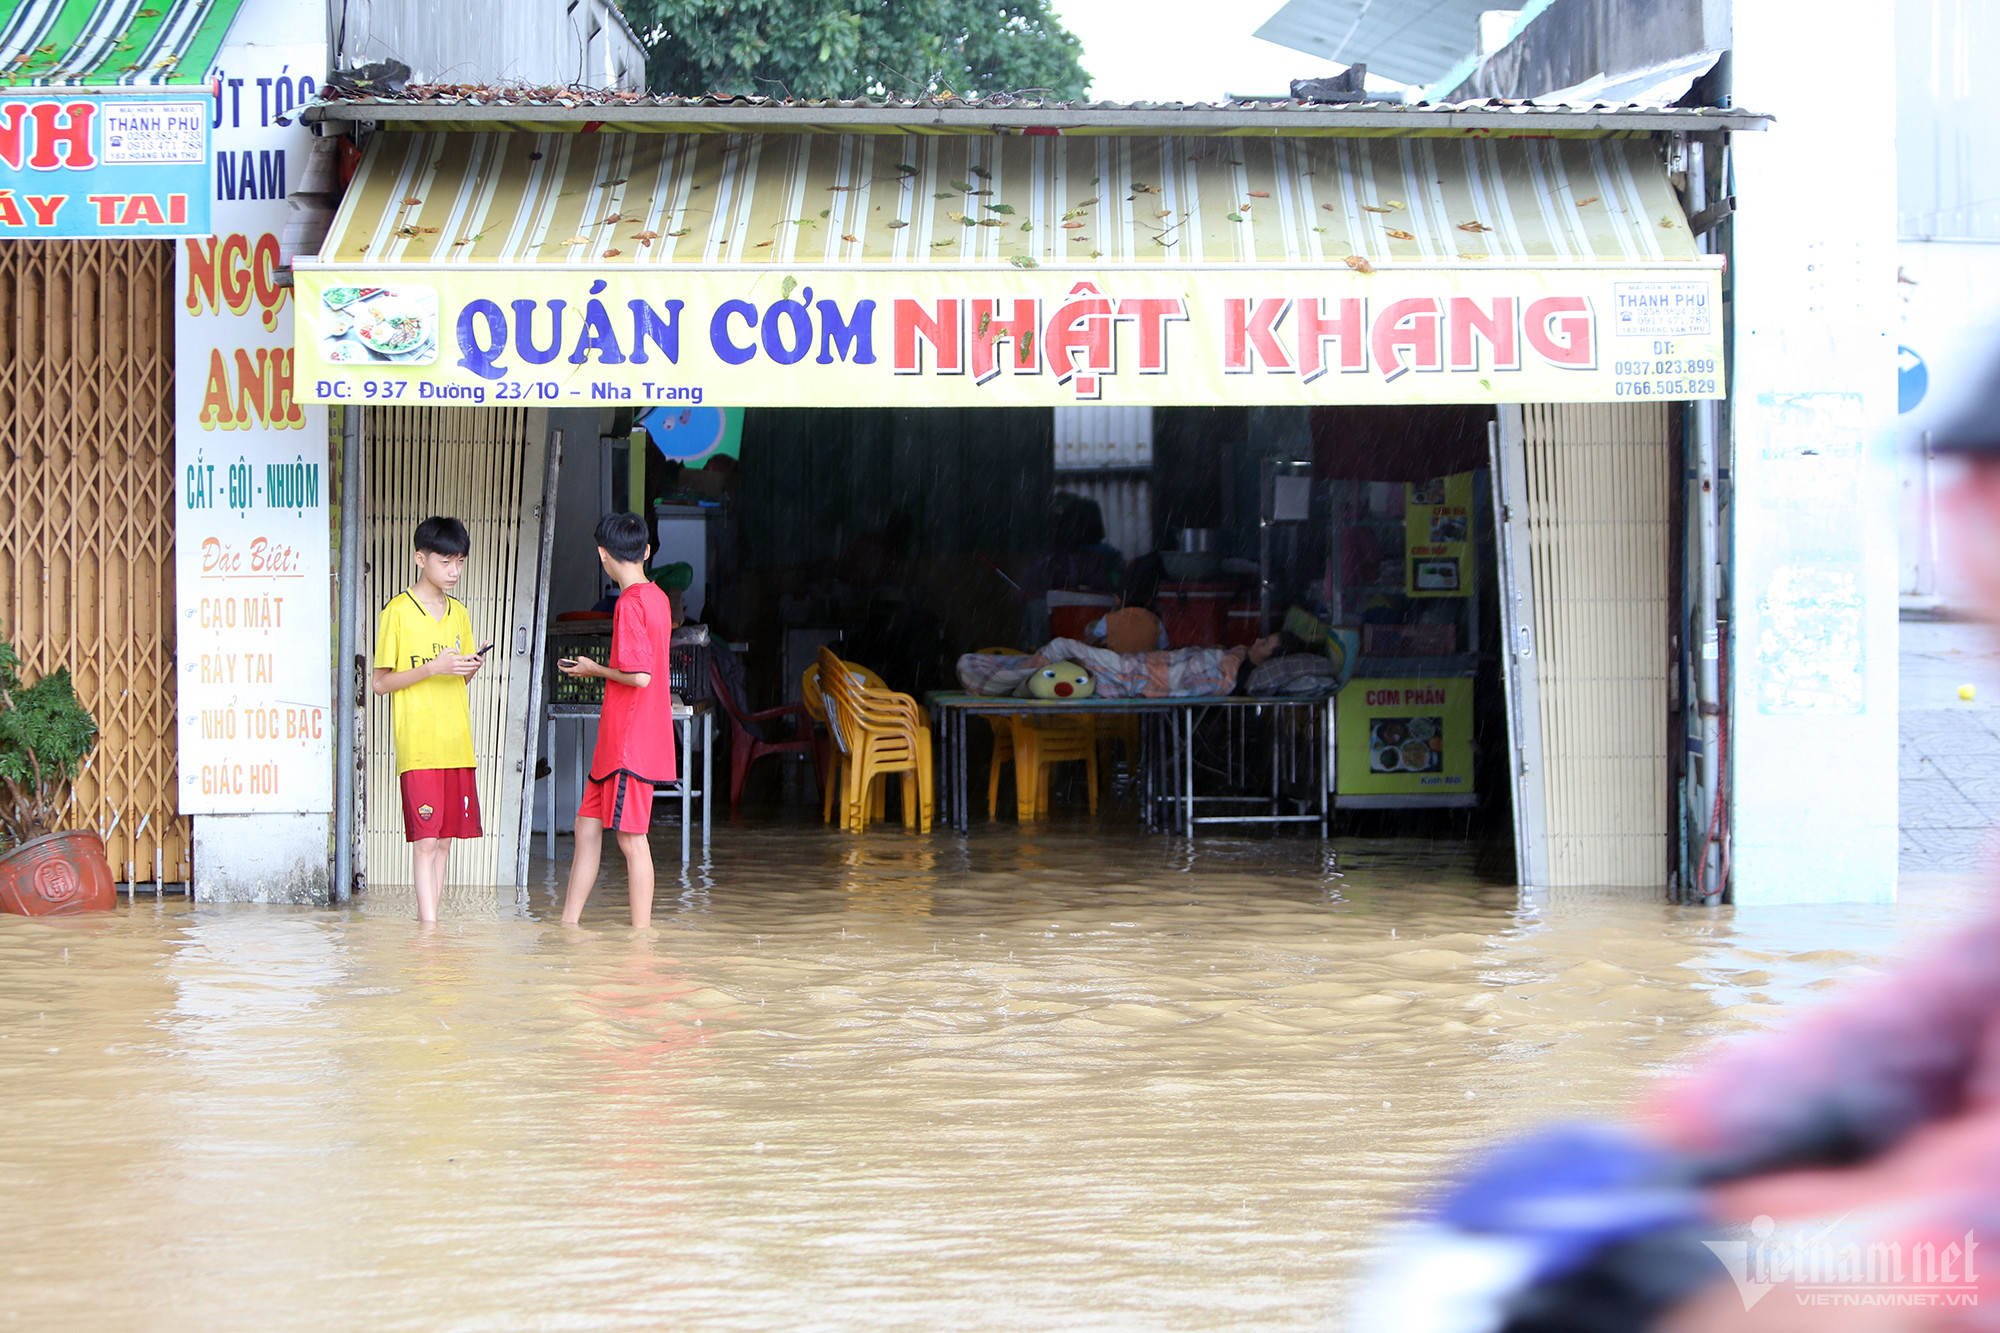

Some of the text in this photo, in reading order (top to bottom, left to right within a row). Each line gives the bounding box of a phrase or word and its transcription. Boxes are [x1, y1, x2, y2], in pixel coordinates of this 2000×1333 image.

[217, 149, 285, 200] NAM
[89, 195, 186, 225] TAI
[185, 232, 295, 332] NGỌ
[456, 279, 1599, 400] QUÁN CƠM NHẬT KHANG
[199, 347, 304, 430] ANH
[1615, 359, 1715, 375] 0937.023.899
[1615, 379, 1715, 395] 0766.505.829
[316, 381, 351, 398] ĐC:
[363, 381, 407, 399] 937
[418, 381, 485, 403] Đường
[495, 381, 559, 400] 23/10
[591, 382, 631, 399] Nha
[642, 382, 703, 403] Trang
[187, 448, 215, 509] CẮT
[229, 455, 253, 519] GỘI
[267, 454, 319, 518] NHUỘM
[202, 536, 300, 581] Đặc Biệt:
[201, 592, 283, 636] CẠO MẶT
[201, 646, 273, 684] RÁY TAI
[1366, 688, 1400, 705] CƠM
[201, 695, 322, 747] NHỔ TÓC BẠC
[202, 757, 279, 795] GIÁC HƠI
